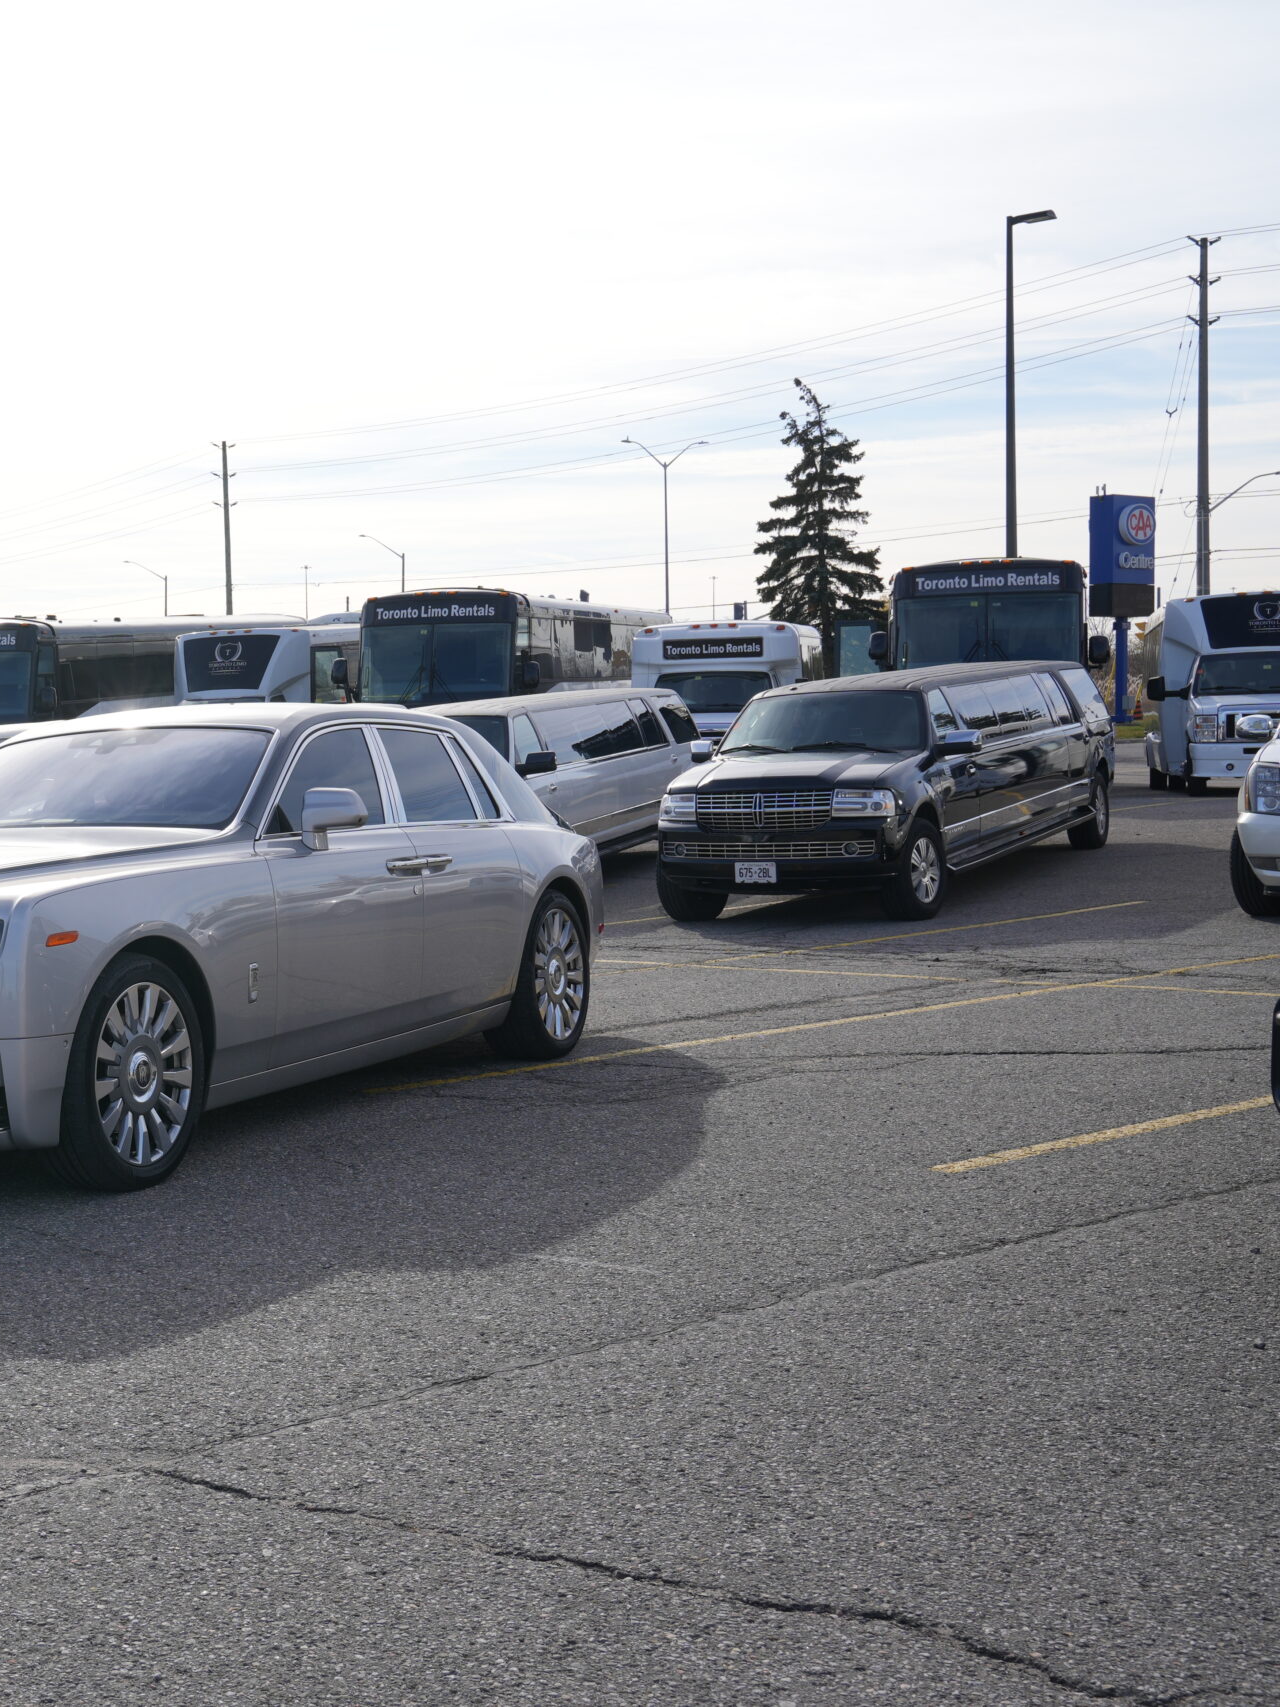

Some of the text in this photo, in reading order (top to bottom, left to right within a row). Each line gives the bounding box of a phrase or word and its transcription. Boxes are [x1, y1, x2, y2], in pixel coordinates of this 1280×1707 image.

[1129, 508, 1152, 538] CAA
[1121, 551, 1154, 569] Centre
[916, 571, 1061, 590] Toronto Limo Rentals
[376, 603, 495, 620] Toronto Limo Rentals
[666, 642, 761, 655] Toronto Limo Rentals
[738, 867, 773, 878] 675 2BL
